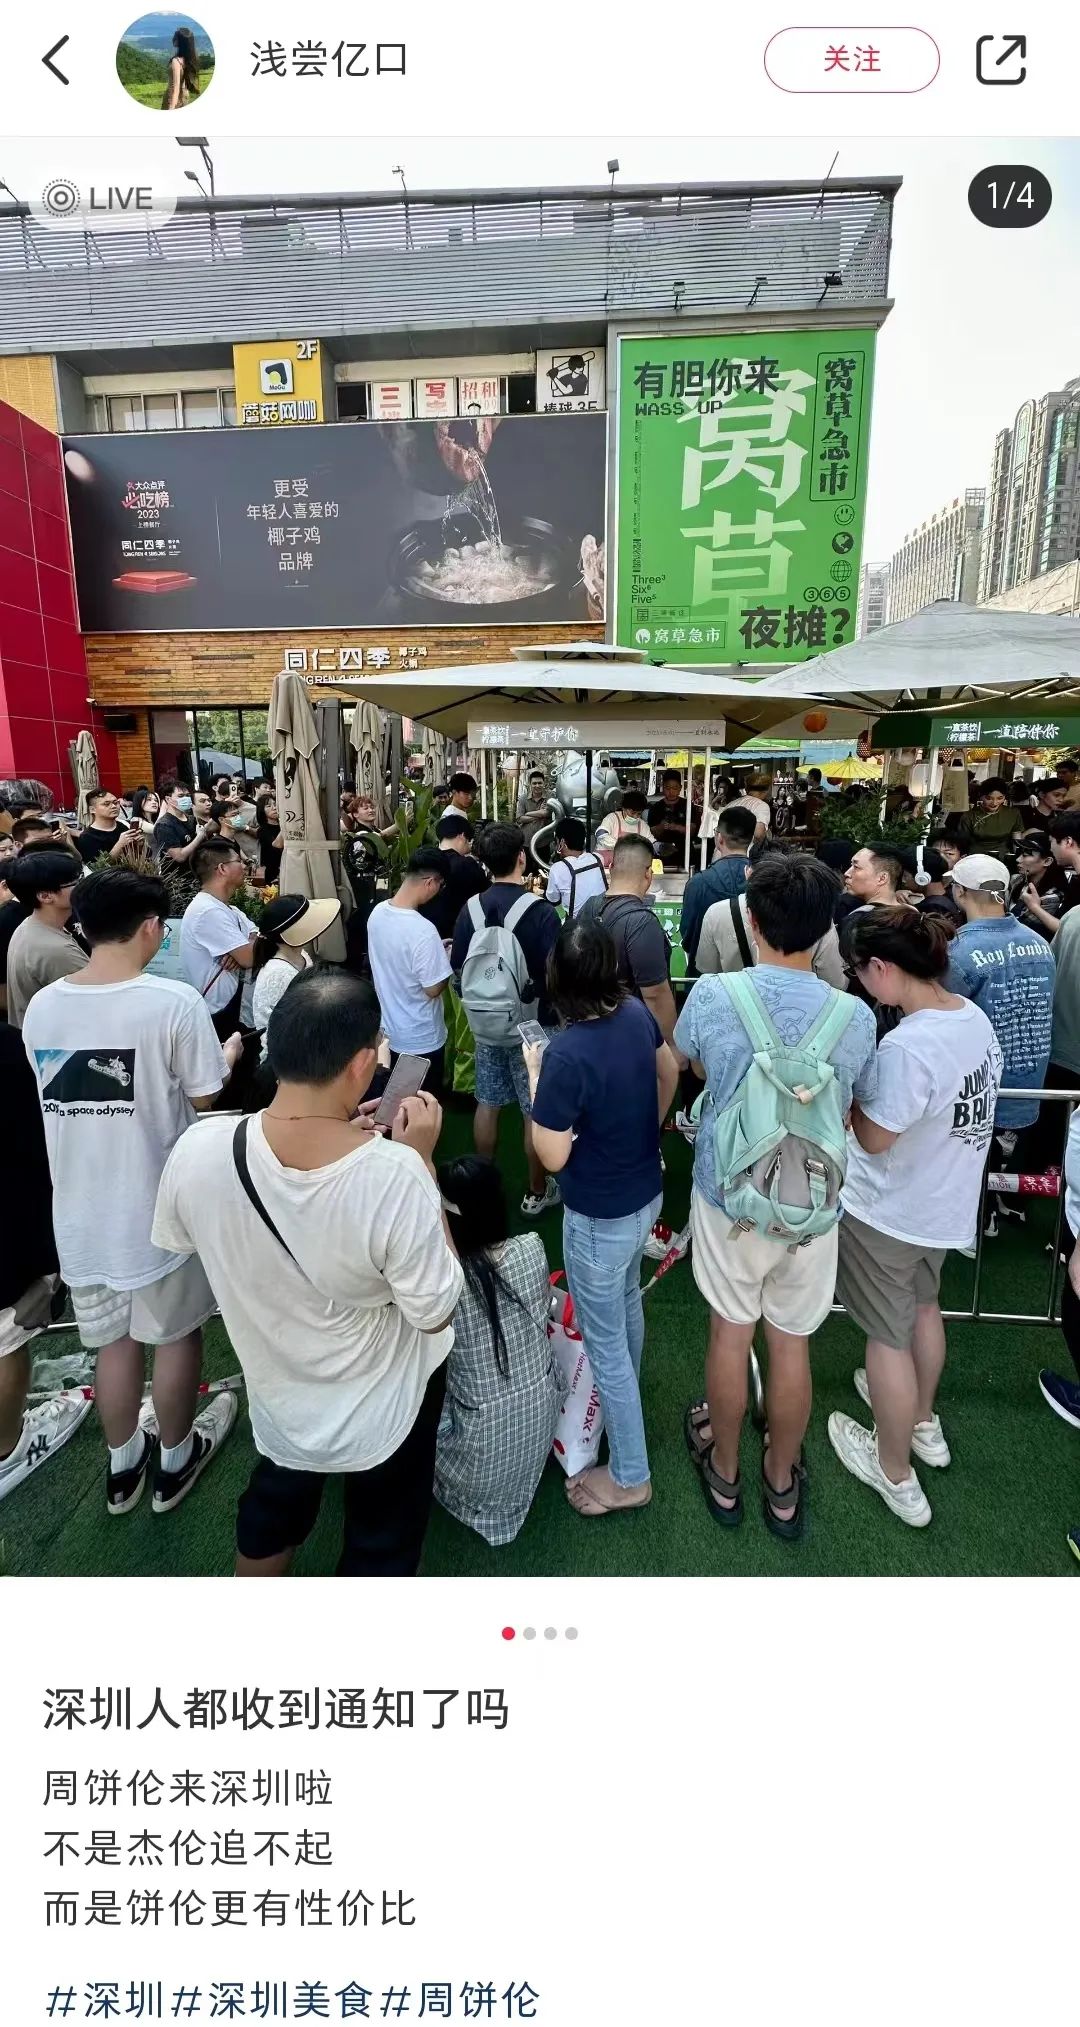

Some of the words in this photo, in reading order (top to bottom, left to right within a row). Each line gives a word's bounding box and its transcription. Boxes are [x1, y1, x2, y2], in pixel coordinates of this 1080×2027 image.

[297, 340, 317, 359] 2F
[633, 356, 780, 399] 有胆你来
[242, 400, 317, 423] 蘑菇网咖
[635, 402, 685, 416] WASS
[697, 401, 723, 415] UP
[818, 357, 857, 496] 窝草急市
[135, 481, 166, 490] 大众点评
[273, 479, 309, 499] 更受
[121, 491, 170, 509] 必吃榜
[137, 509, 160, 519] 2023
[246, 501, 339, 521] 年轻人喜爱的
[267, 525, 321, 546] 椰子鸡
[121, 540, 166, 550] 同仁四季
[278, 551, 314, 571] 品牌
[654, 627, 721, 644] 窝草急市
[284, 647, 391, 672] 同仁四季
[943, 722, 978, 732] 一直茶饮
[982, 723, 1060, 741] 一直陪伴你
[67, 1106, 95, 1118] space
[96, 1104, 136, 1117] odyssey
